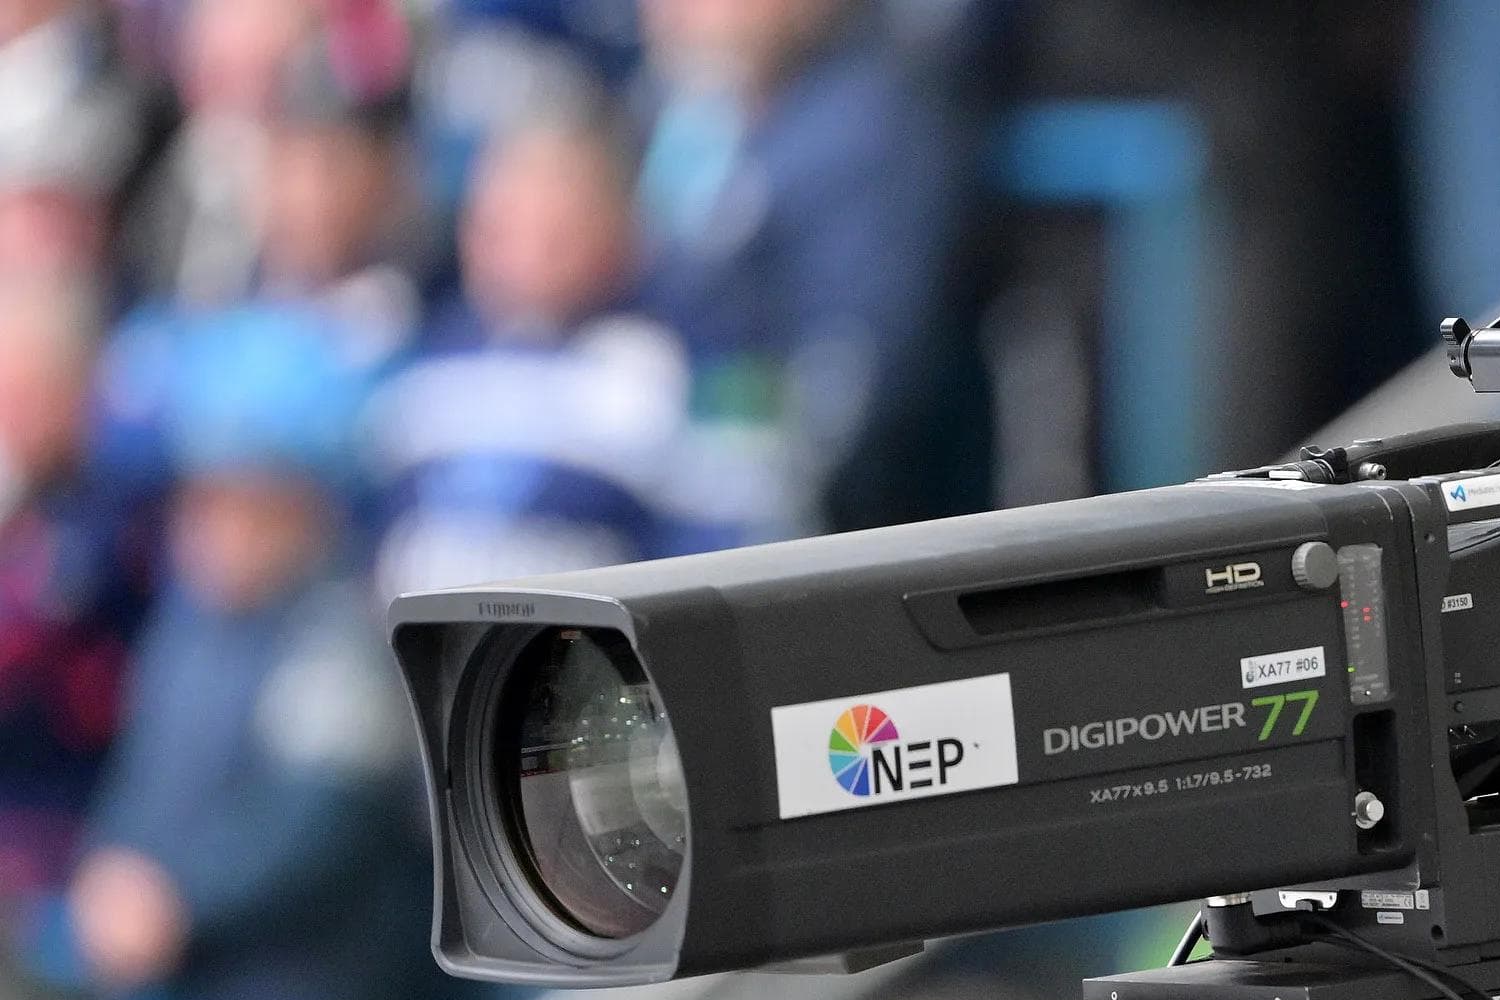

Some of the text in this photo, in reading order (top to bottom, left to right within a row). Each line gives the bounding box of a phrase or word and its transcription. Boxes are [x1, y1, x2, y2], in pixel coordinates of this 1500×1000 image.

[1205, 562, 1261, 588] HD
[1258, 655, 1319, 679] XA77 #06
[1043, 689, 1320, 755] DIGIPOWER 77
[872, 738, 964, 794] NEP
